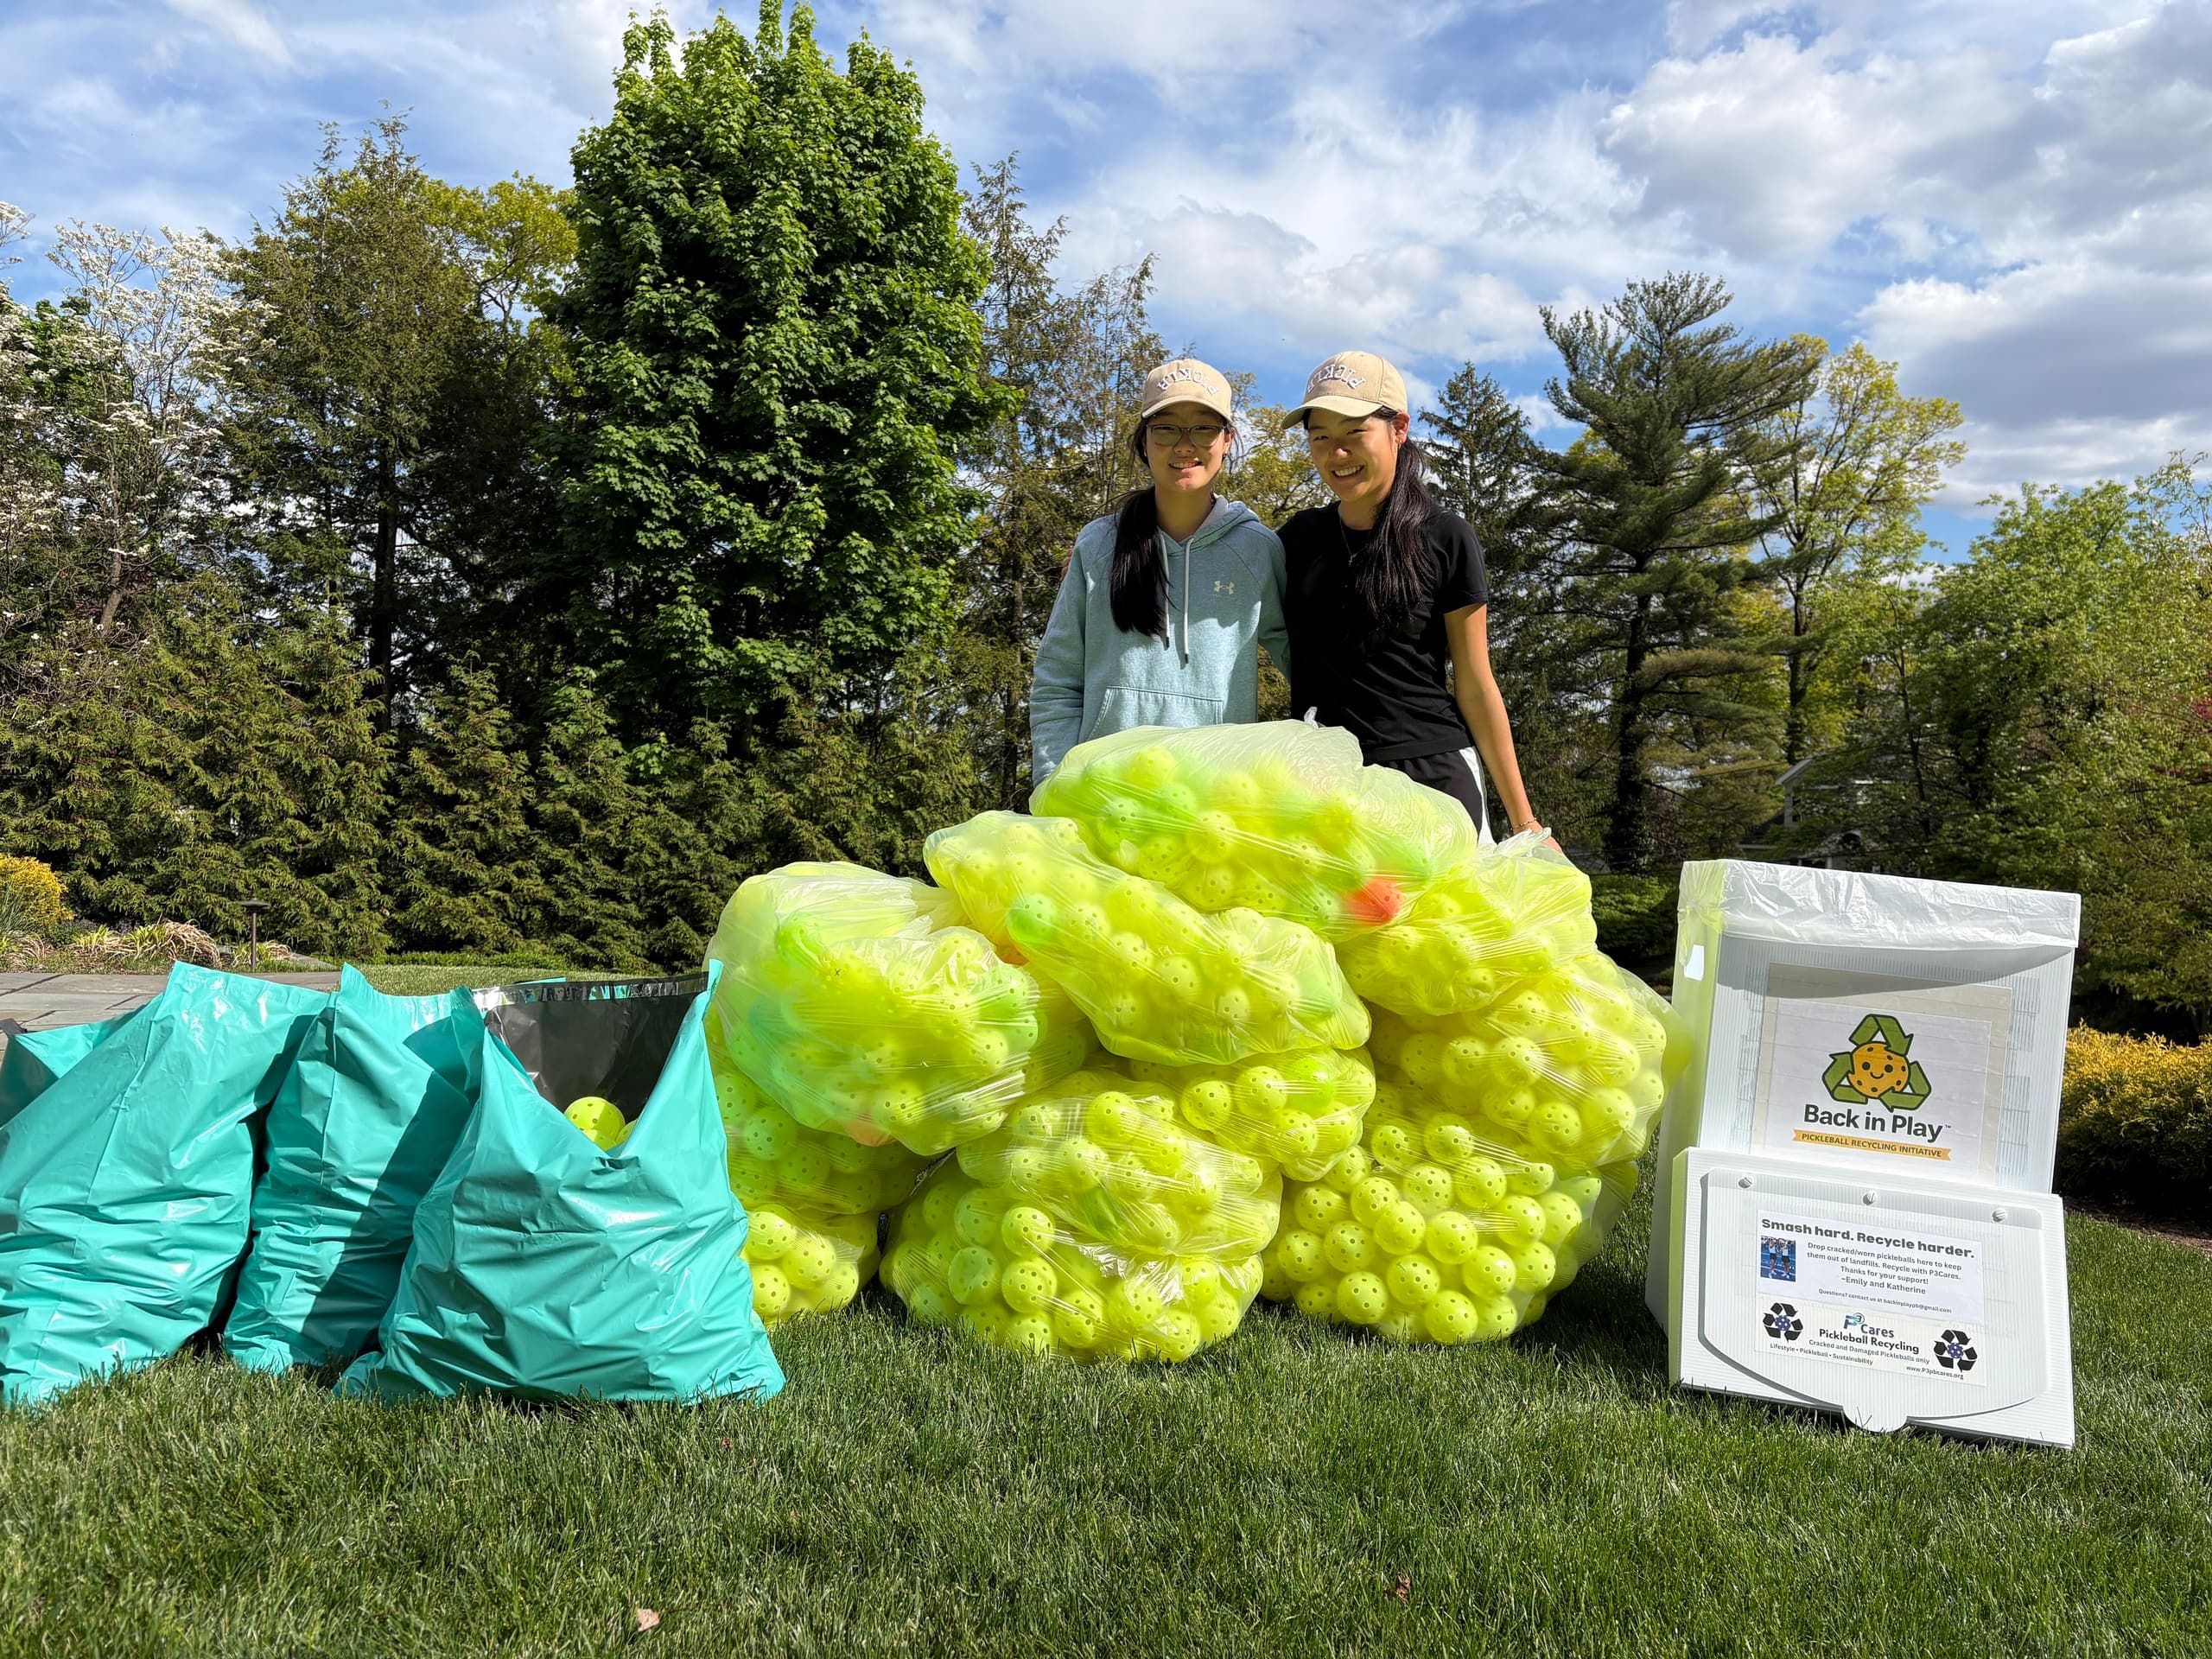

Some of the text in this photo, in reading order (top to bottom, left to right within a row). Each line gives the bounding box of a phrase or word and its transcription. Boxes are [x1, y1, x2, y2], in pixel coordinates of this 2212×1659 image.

[1804, 1103, 1859, 1129] Back
[1866, 1111, 1885, 1131] in
[1802, 1133, 1942, 1158] PICKLEBALL RECYCLING INITIATIVE
[1762, 1218, 1974, 1258] Smash hard. Recycle harder.
[1808, 1242, 1826, 1251] Drop
[1827, 1246, 1875, 1258] cracked/worn
[1877, 1253, 1916, 1264] pickleballs
[1916, 1258, 1933, 1267] here
[1944, 1262, 1962, 1271] keep
[1850, 1257, 1880, 1268] landfills.
[1882, 1262, 1910, 1273] Recycle
[1840, 1266, 1866, 1275] Thanks
[1897, 1275, 1929, 1285] support!
[1818, 1288, 1847, 1298] Questions?
[1886, 1282, 1926, 1294] Katherine
[1819, 1329, 1919, 1355] Pickleball Recycling
[1860, 1324, 1895, 1338] Cares
[1770, 1343, 1873, 1365] Lifestyle Pickleball Sustainability
[1808, 1339, 1834, 1349] Cracked
[1849, 1345, 1878, 1356] Damaged
[1880, 1351, 1915, 1362] Pickleballs
